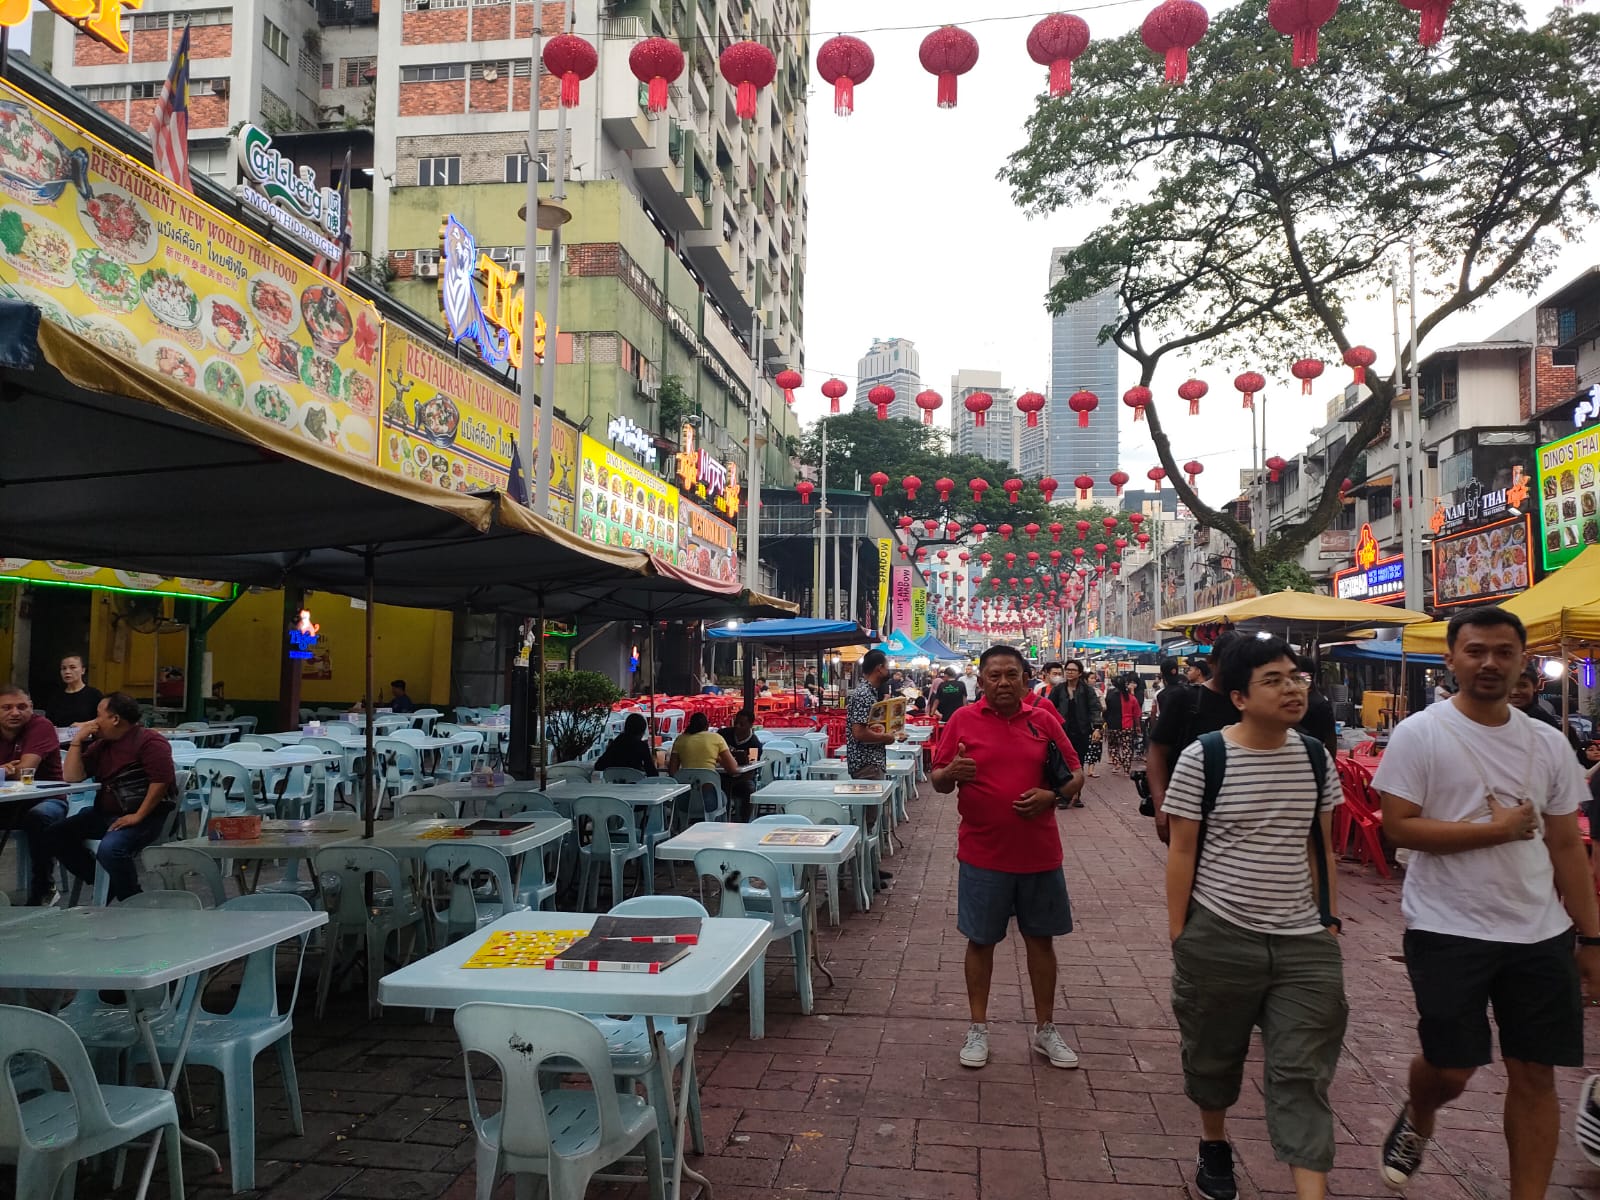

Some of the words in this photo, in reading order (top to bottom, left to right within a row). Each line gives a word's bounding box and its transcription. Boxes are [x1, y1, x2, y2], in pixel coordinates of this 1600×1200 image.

[91, 144, 171, 196] RESTORAN
[244, 125, 323, 220] Carlsberg
[91, 152, 177, 217] RESTAURANT
[179, 203, 206, 233] NEW
[207, 220, 246, 256] WORLD
[247, 243, 271, 271] THAI
[272, 265, 298, 285] FOOD
[243, 187, 292, 229] SMOOTH
[293, 223, 342, 259] DRAUGHT
[480, 252, 560, 369] Tige
[406, 343, 473, 404] RESTAURANT
[475, 384, 494, 417] NEW
[496, 393, 520, 430] WORL
[1543, 443, 1575, 471] DINO'S
[1575, 432, 1599, 458] THAI
[1445, 502, 1466, 521] NAM
[1481, 487, 1507, 509] THAI
[879, 542, 889, 584] SHADOW
[903, 569, 911, 602] SHADOW
[896, 600, 904, 621] LIGHT
